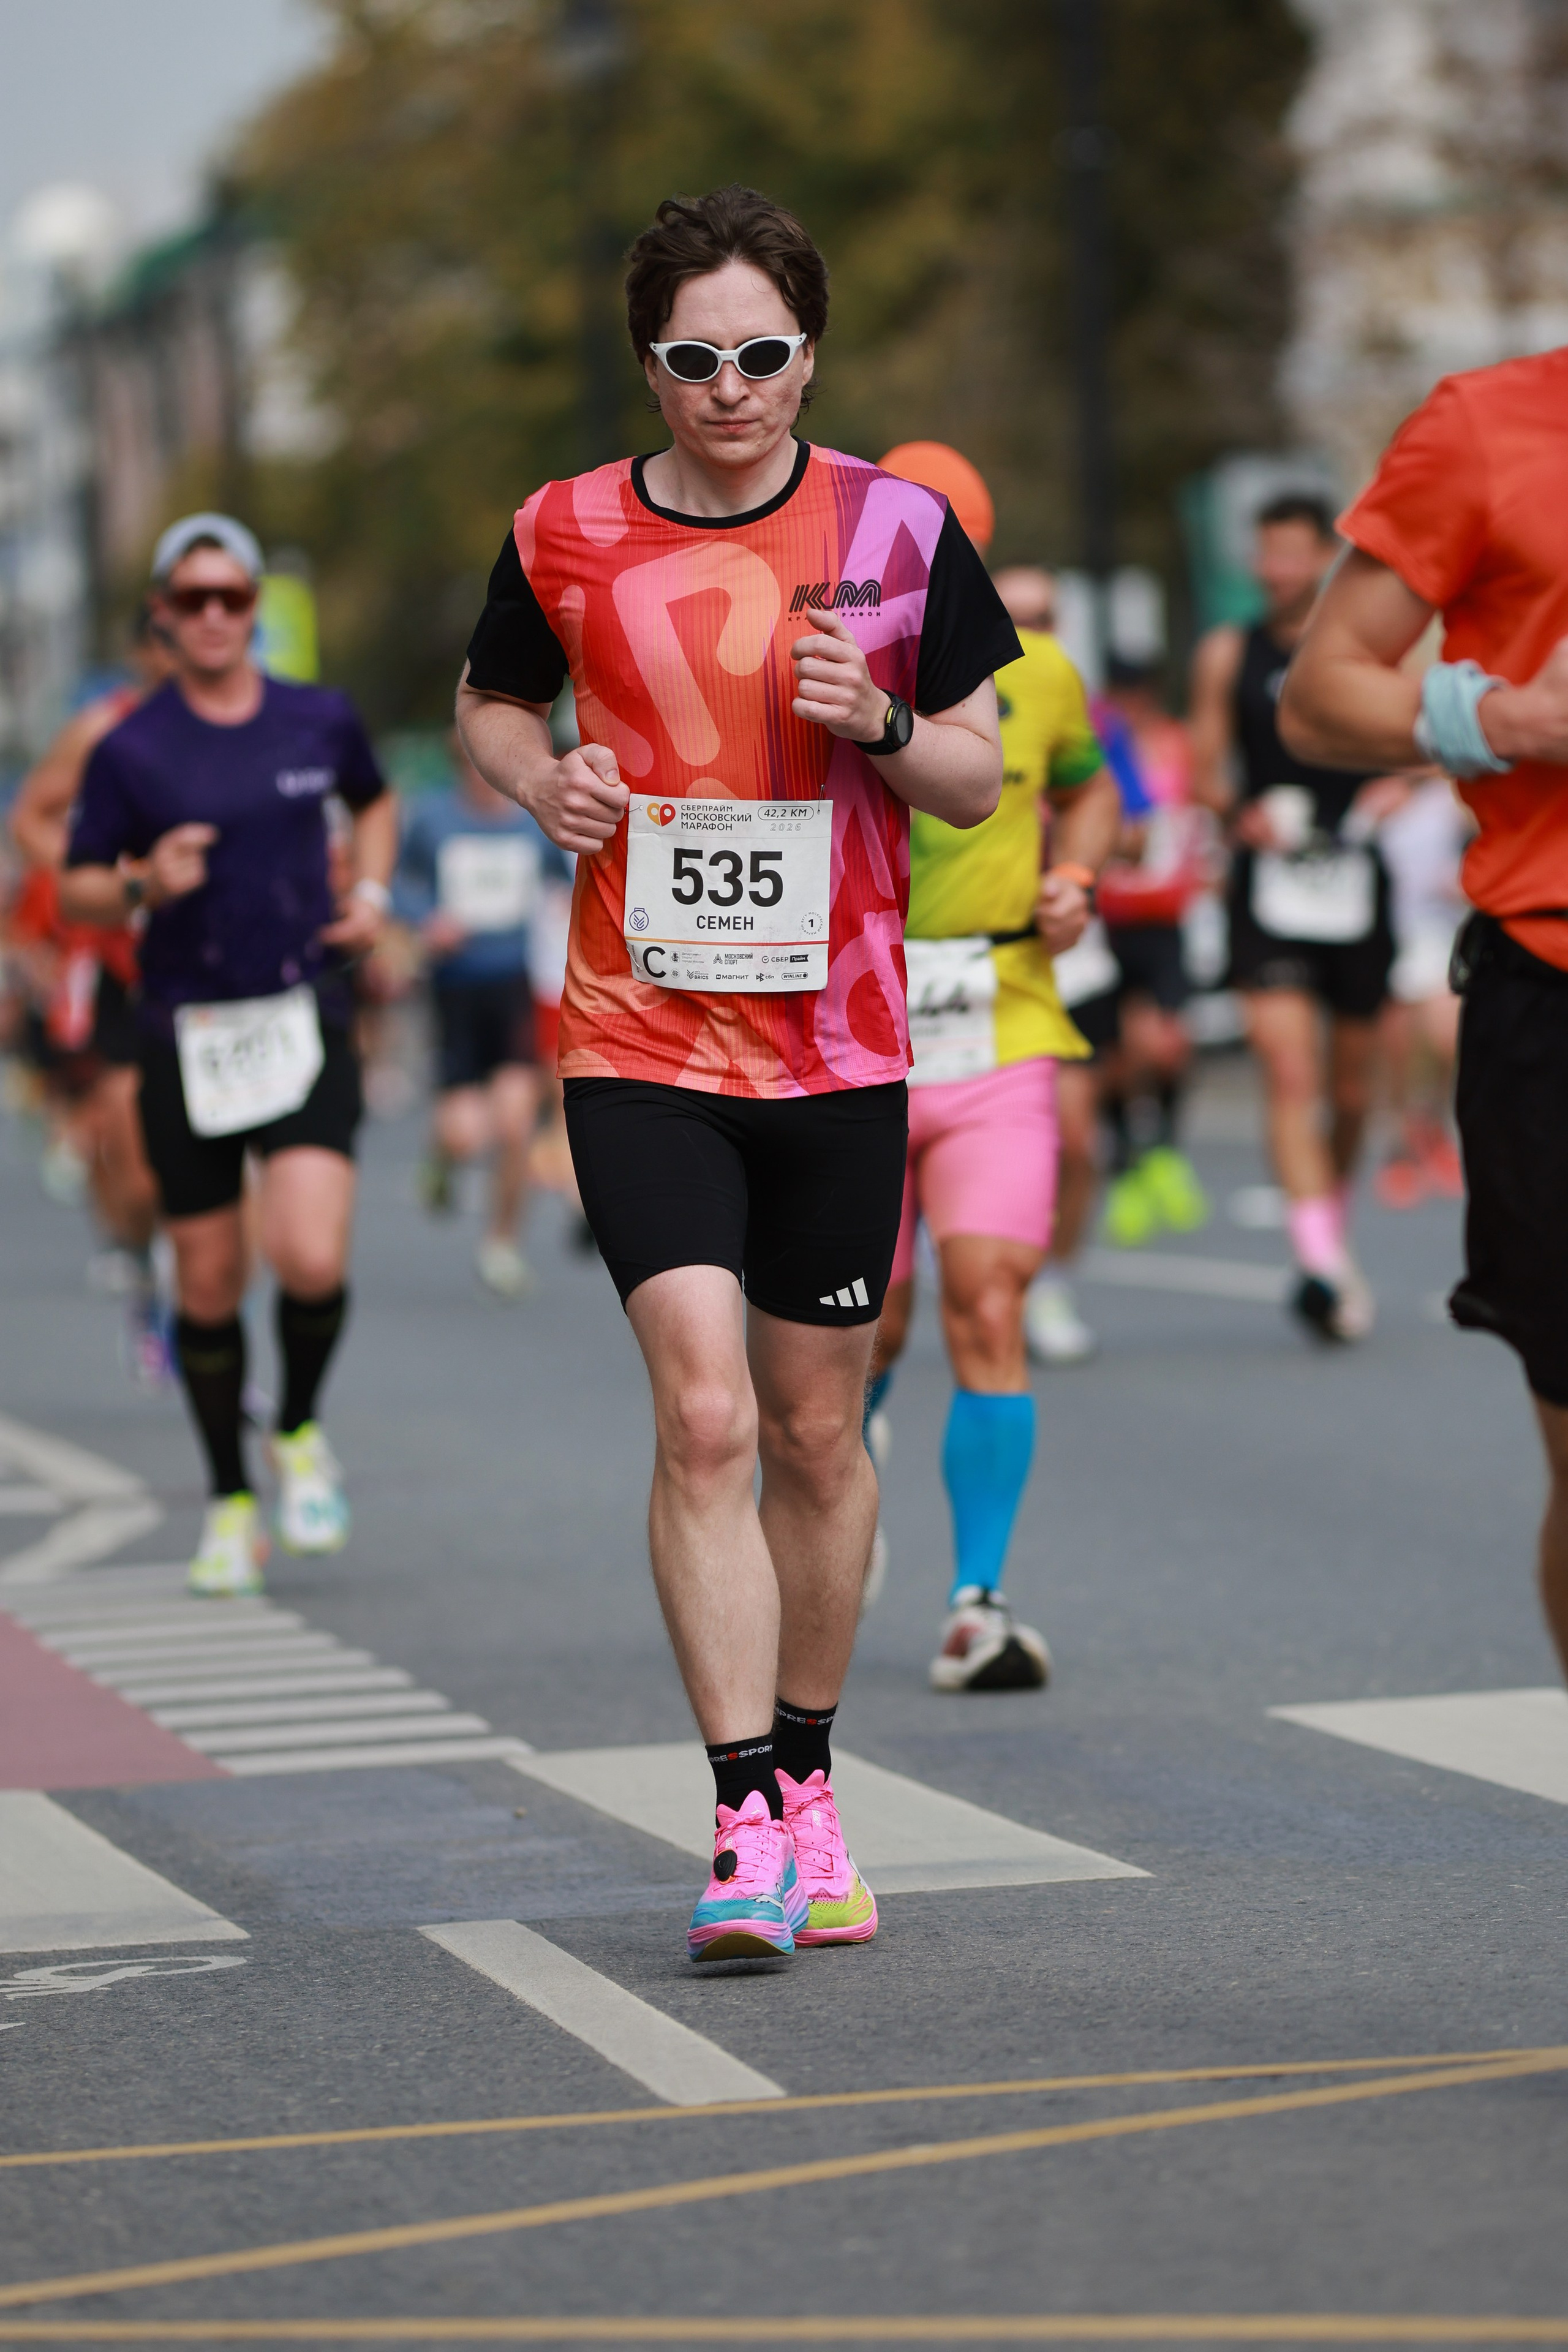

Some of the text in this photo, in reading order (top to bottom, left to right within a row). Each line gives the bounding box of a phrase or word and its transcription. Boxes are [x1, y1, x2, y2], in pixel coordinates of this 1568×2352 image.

[680, 812, 752, 822] МОСКОВСКИЙ
[764, 809, 786, 818] 42,2
[680, 821, 733, 831] МАРАФОН
[770, 823, 802, 832] 2026
[671, 848, 783, 907] 535
[696, 915, 754, 930] СЕМЕН
[809, 919, 813, 927] 1
